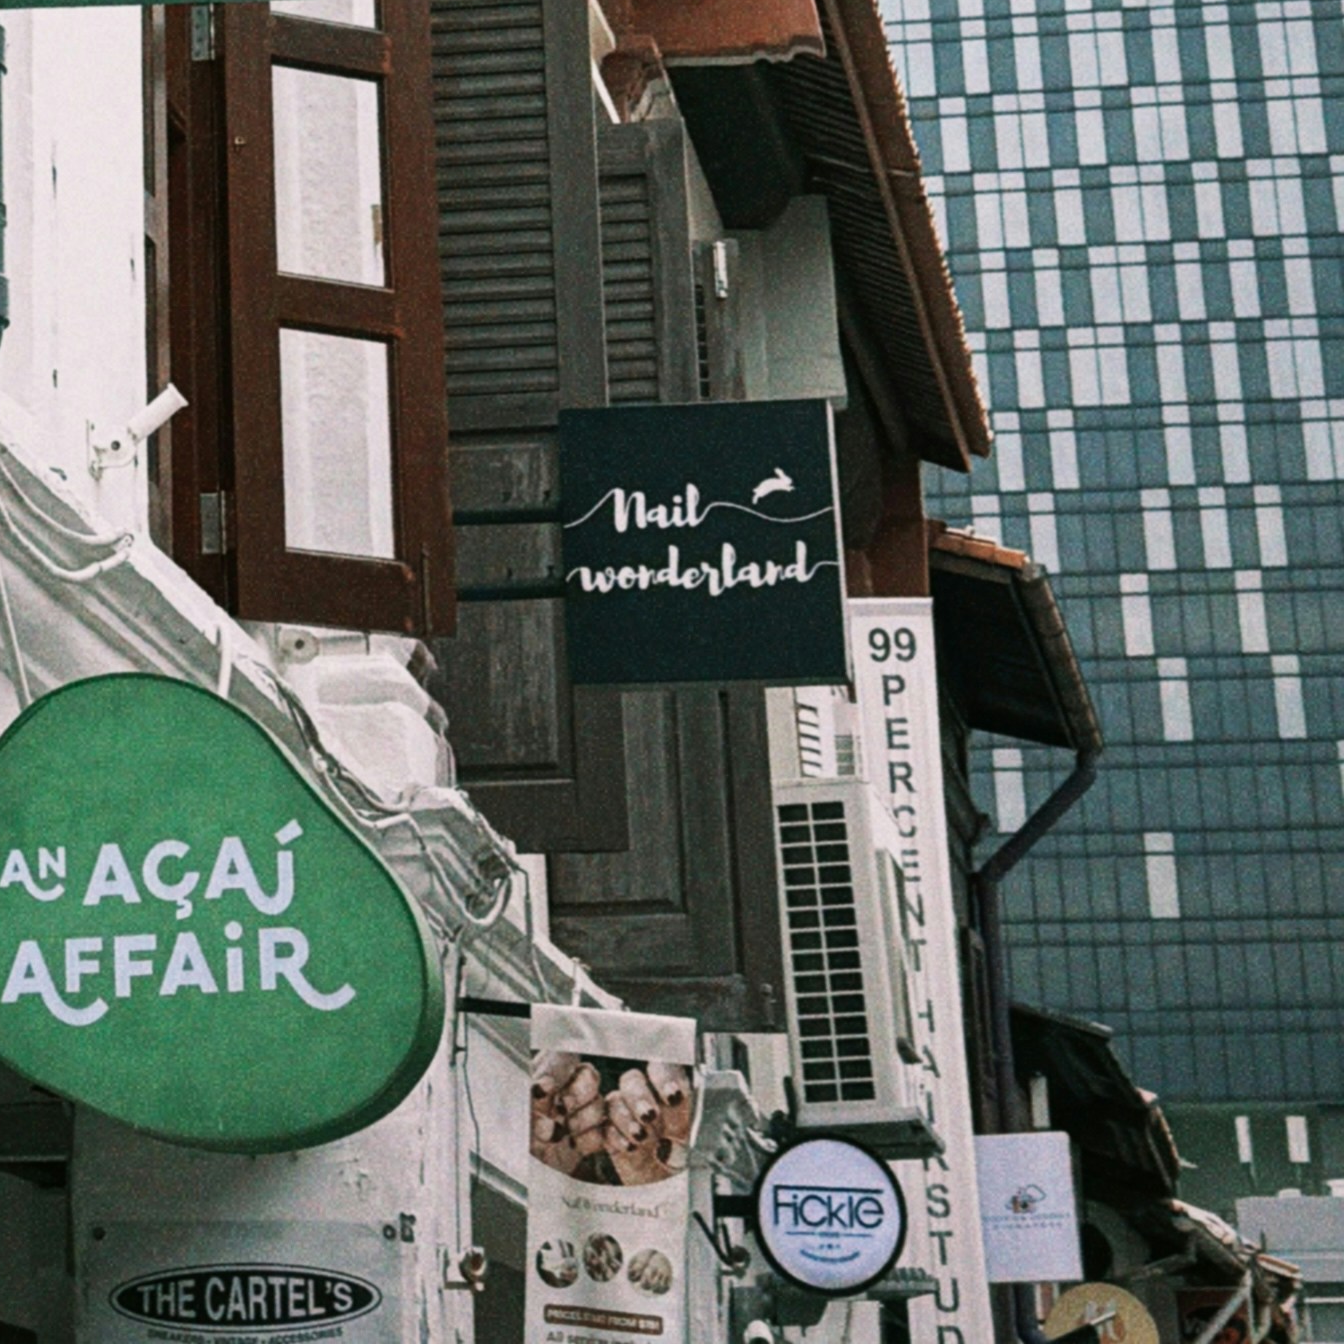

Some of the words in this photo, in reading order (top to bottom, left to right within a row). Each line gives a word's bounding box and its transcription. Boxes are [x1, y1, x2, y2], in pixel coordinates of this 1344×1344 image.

[599, 483, 718, 533] Nail
[566, 540, 824, 597] wonderland
[867, 627, 917, 663] 99
[137, 1279, 196, 1318] THE
[206, 1275, 354, 1321] CARTEL'S
